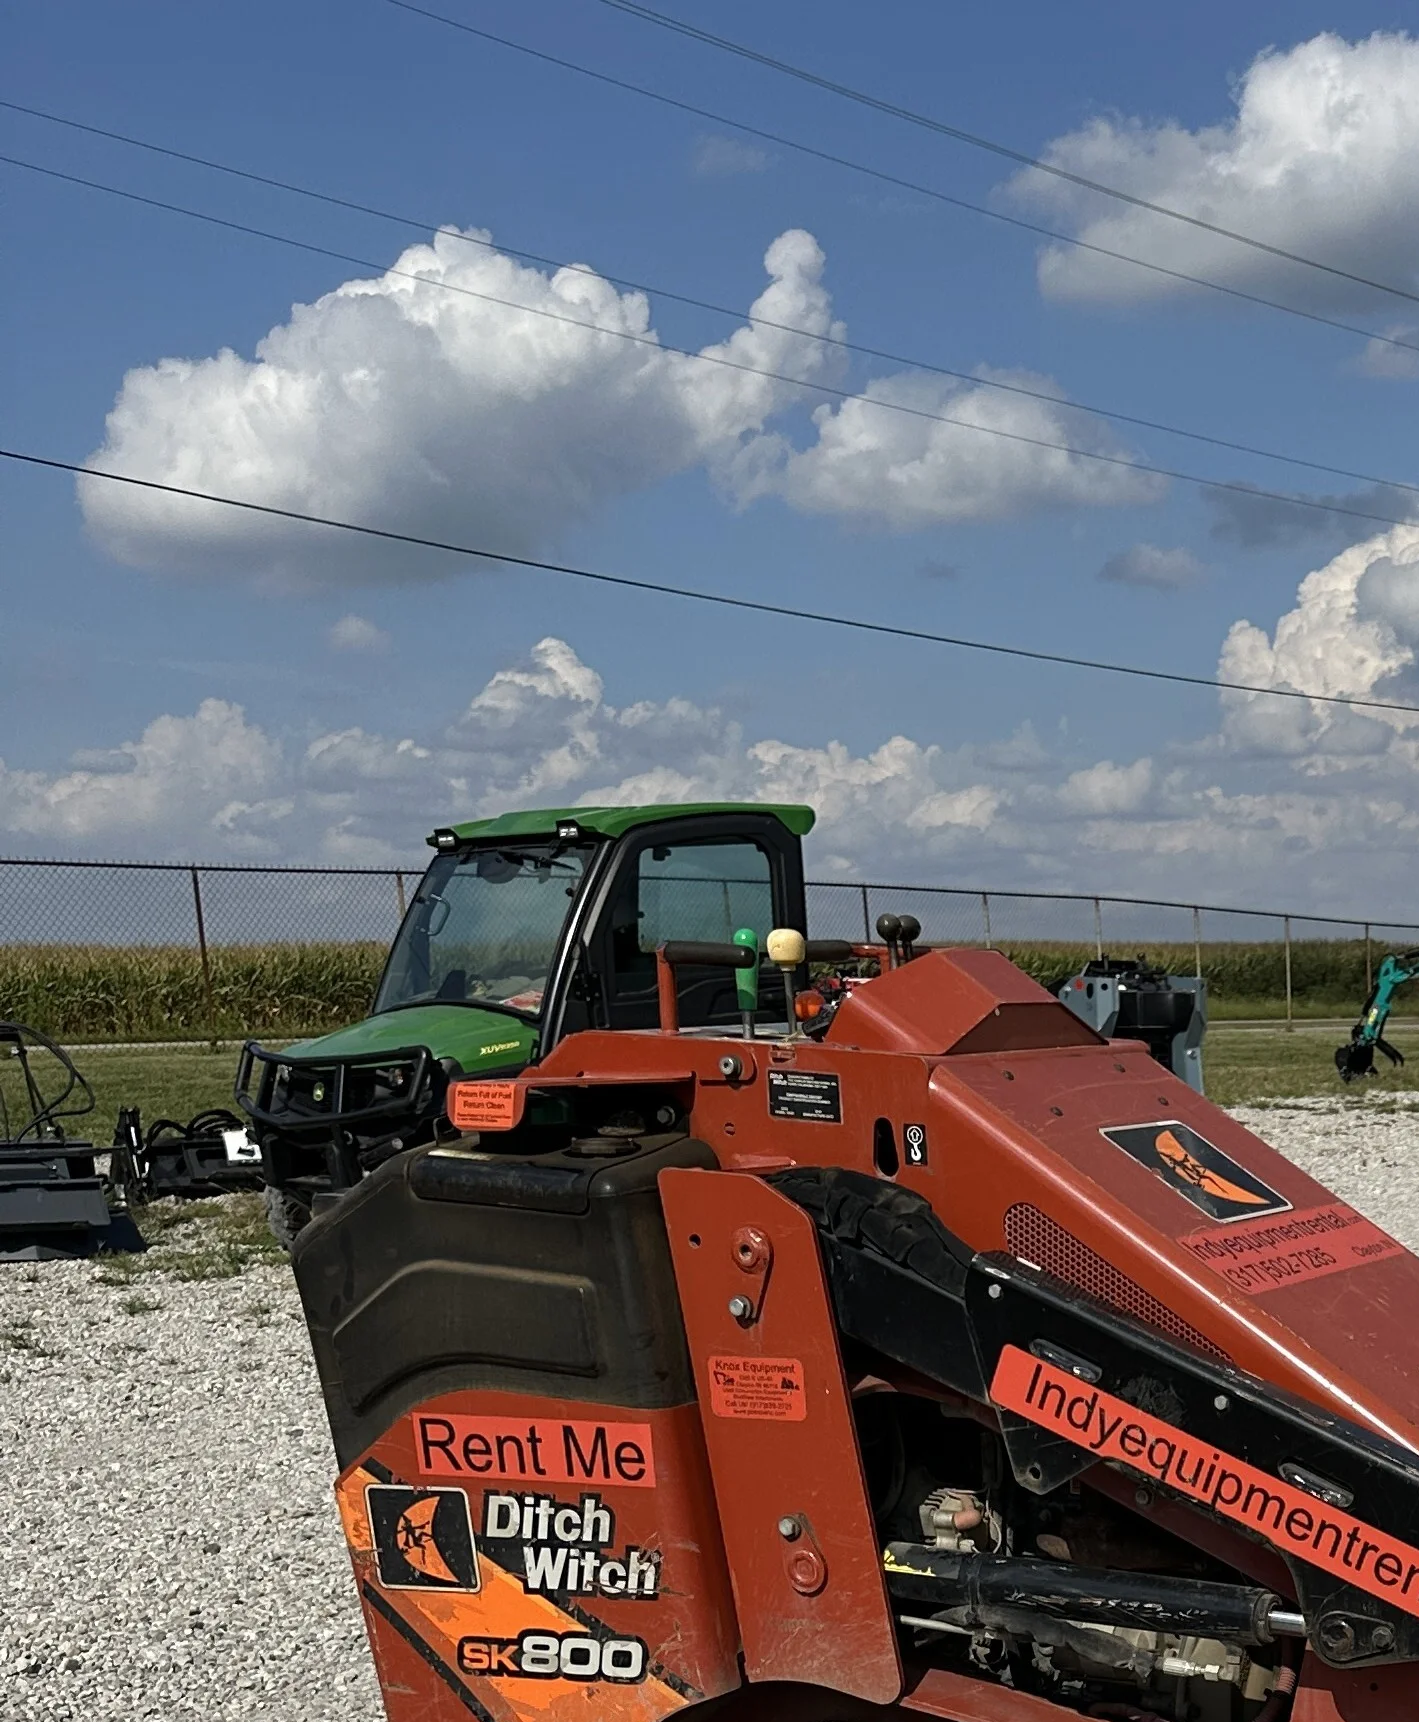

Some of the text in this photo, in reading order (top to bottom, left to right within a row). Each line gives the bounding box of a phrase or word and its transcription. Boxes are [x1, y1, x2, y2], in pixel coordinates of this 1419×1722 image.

[715, 1360, 795, 1374] Knox Equipment
[419, 1417, 646, 1481] Rent Me
[486, 1495, 611, 1543] Ditch
[523, 1546, 656, 1595] Witch
[463, 1635, 643, 1679] SK800
